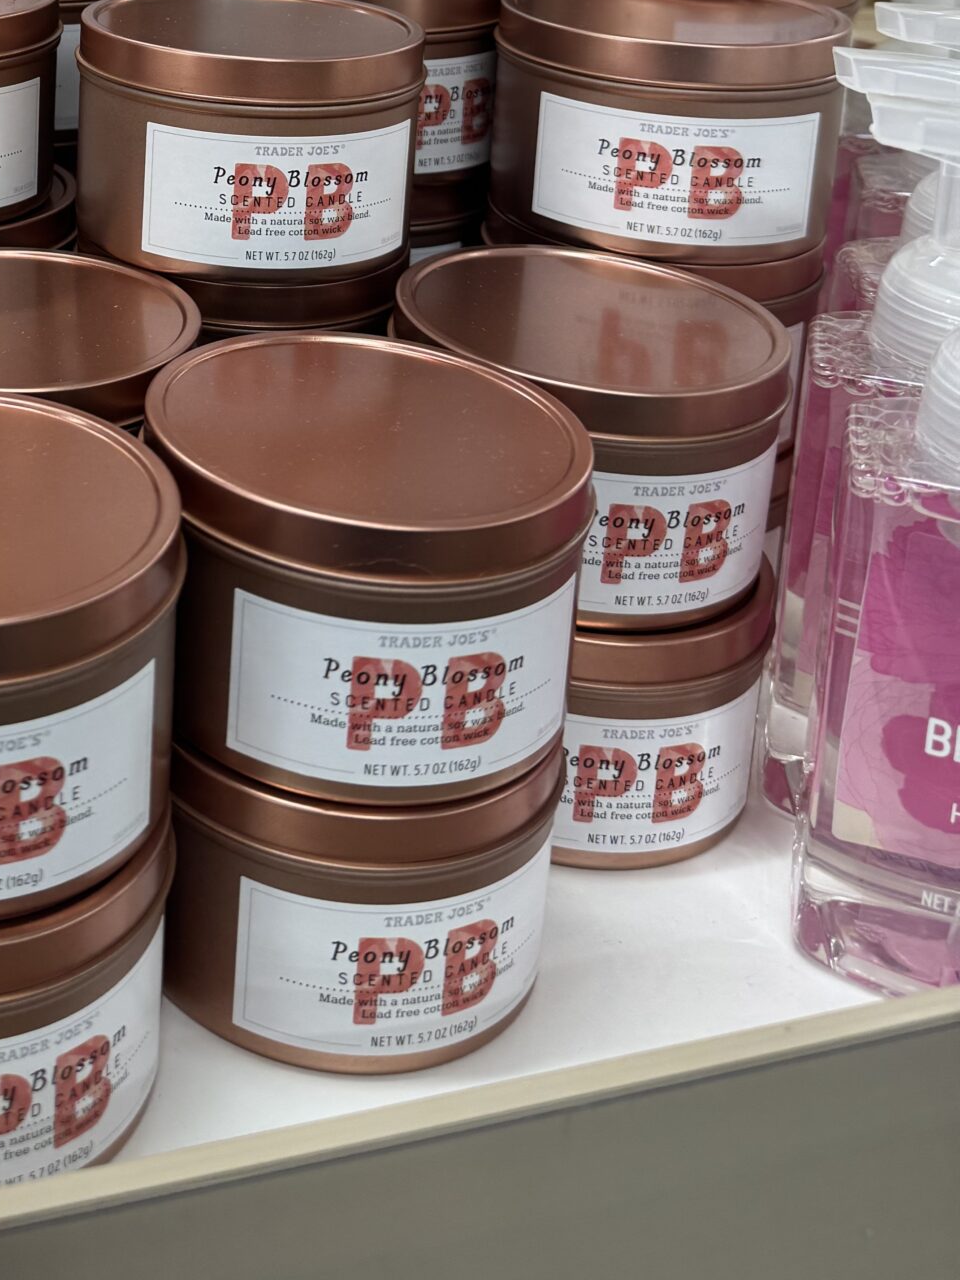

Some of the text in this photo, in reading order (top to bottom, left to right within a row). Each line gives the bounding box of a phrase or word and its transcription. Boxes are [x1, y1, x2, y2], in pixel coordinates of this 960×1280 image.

[639, 122, 691, 137] TRADER
[255, 146, 305, 156] TRADER
[597, 138, 761, 172] Peony Blossom
[213, 166, 368, 196] Peony Blossom
[602, 164, 754, 188] SCENTED CANDLE
[219, 190, 362, 208] SCENTED CANDLE
[633, 485, 687, 497] TRADER
[594, 502, 745, 538] eony Blossom
[588, 524, 738, 550] SCENTED CANDLE
[379, 635, 444, 648] TRADER
[323, 655, 525, 698] Peony Blossom
[330, 681, 517, 711] SCENTED CANDLE
[602, 729, 656, 739] TRADER
[637, 745, 721, 771] Blossom
[654, 766, 714, 791] CANDLE
[921, 889, 951, 914] NET
[384, 910, 444, 928] TRADER
[331, 915, 514, 973] Peony Blossom
[338, 940, 508, 986] SCENTED CANDLE
